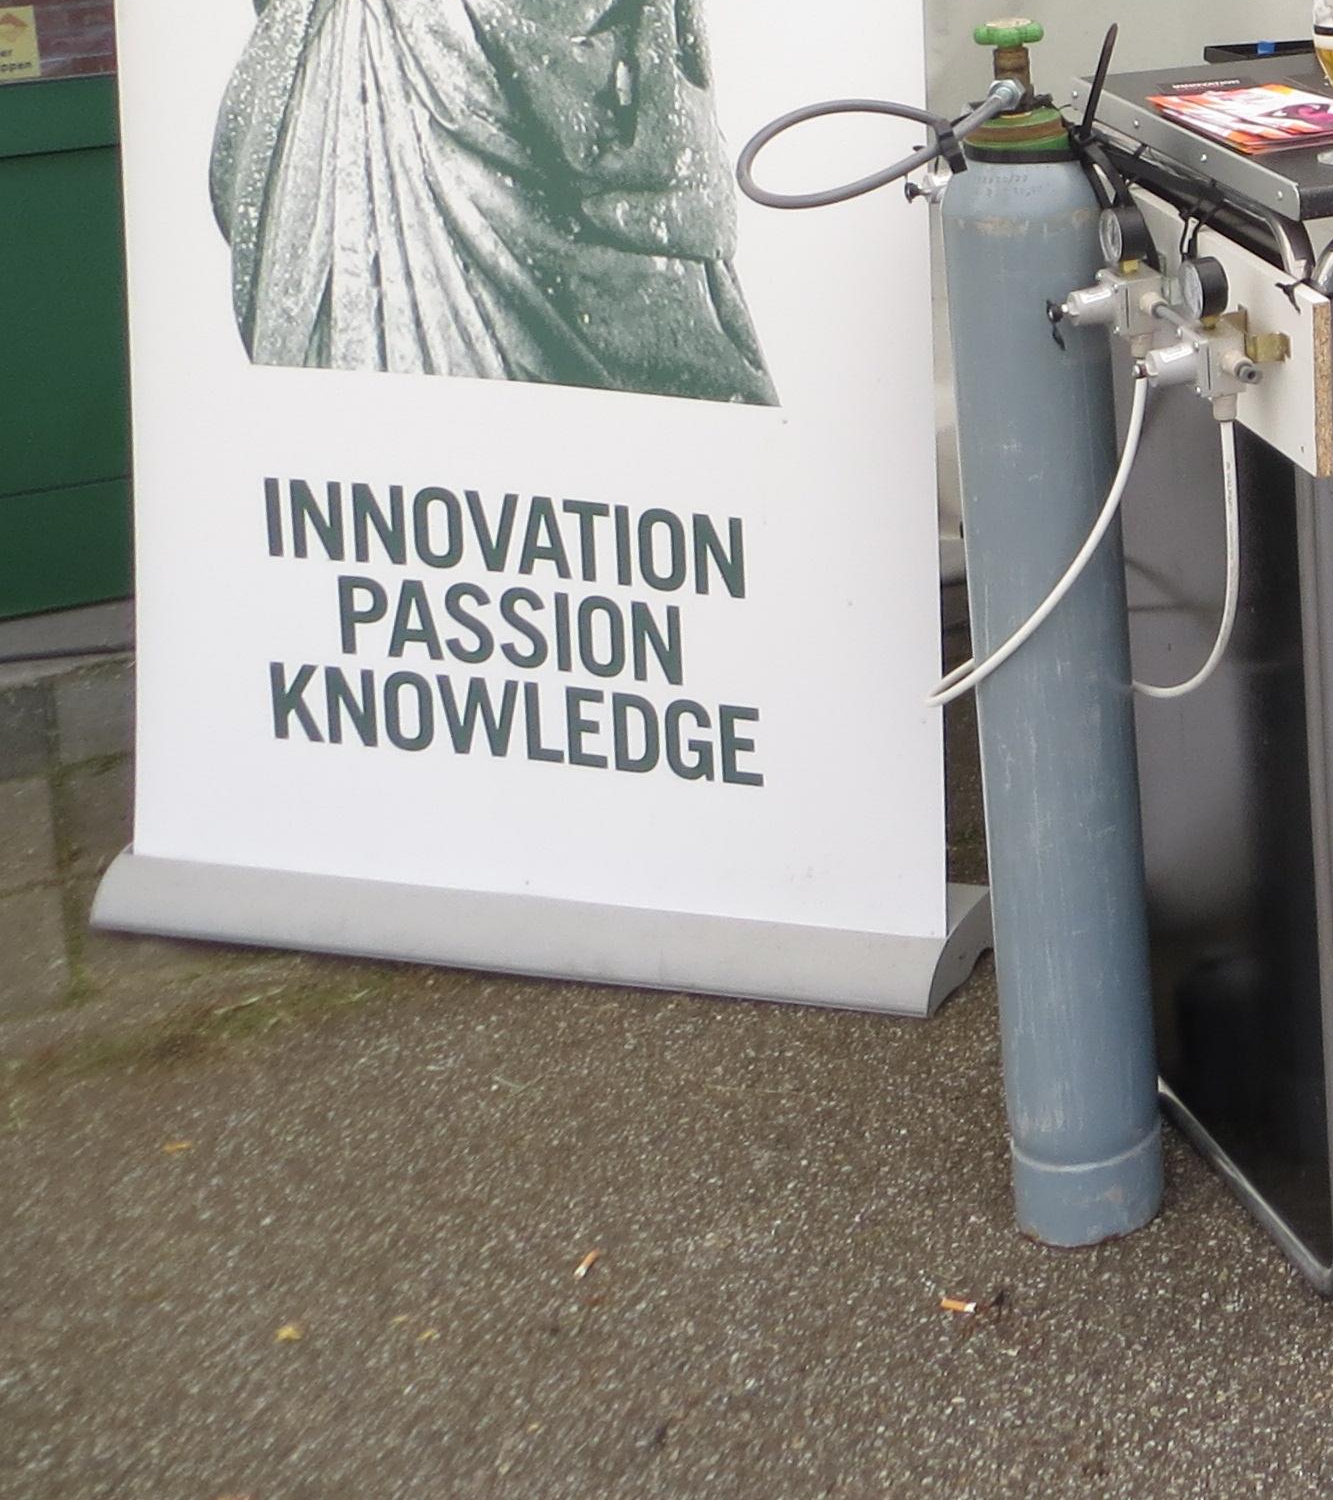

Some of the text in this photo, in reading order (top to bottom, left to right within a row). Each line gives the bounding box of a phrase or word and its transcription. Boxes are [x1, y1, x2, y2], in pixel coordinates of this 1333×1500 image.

[263, 476, 746, 601] INNOVATION
[336, 574, 684, 686] PASSION
[268, 661, 765, 788] KNOWLEDGE
